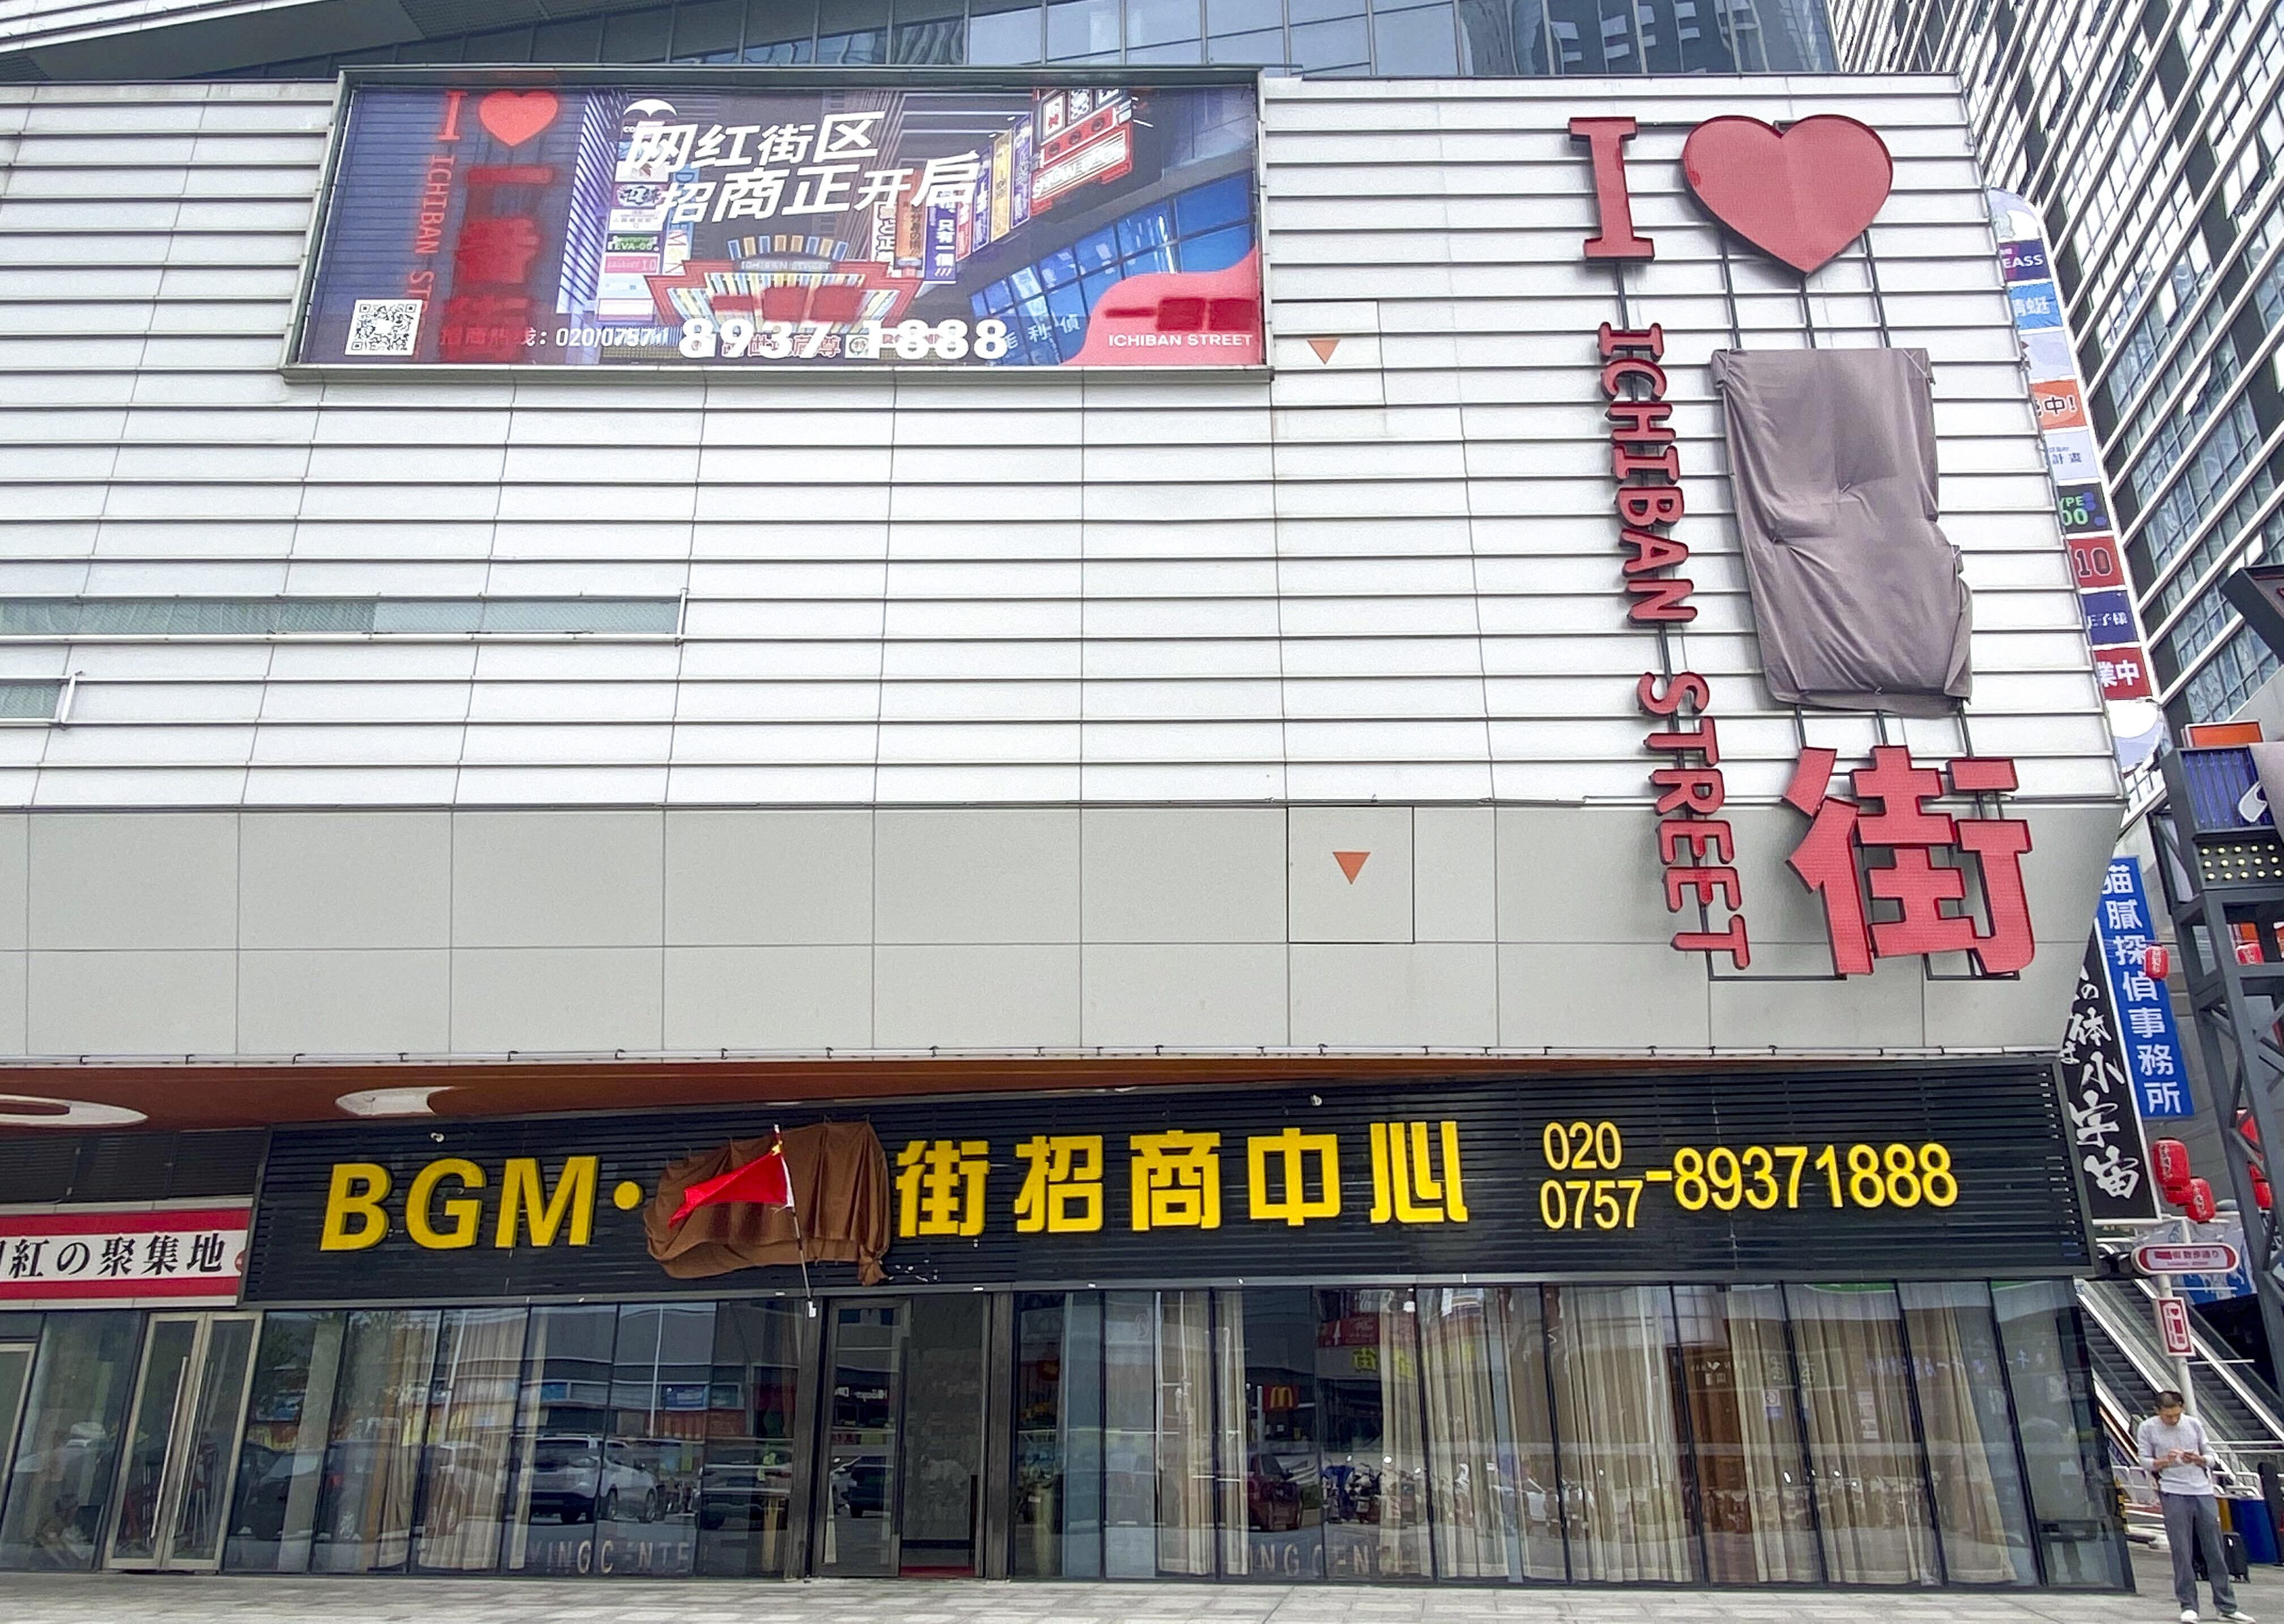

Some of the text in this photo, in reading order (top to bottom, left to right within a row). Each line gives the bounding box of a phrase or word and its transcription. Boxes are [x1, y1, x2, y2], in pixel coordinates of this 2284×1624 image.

[439, 91, 468, 140] I
[625, 111, 885, 171] 网红街区
[414, 155, 455, 255] ICHIBAN
[654, 150, 979, 224] 招商正开启
[1568, 117, 1655, 262] I
[1109, 334, 1253, 347] ICHIBAN STREET
[2074, 547, 2113, 578] 10
[1597, 322, 1751, 970] ICHIBAN STREET
[1781, 745, 2036, 977] 街
[1542, 1122, 1622, 1171] 020
[896, 1120, 1468, 1237] 街招商中心
[1540, 1179, 1642, 1229] 0757
[0, 1232, 225, 1279] 紅の聚集地
